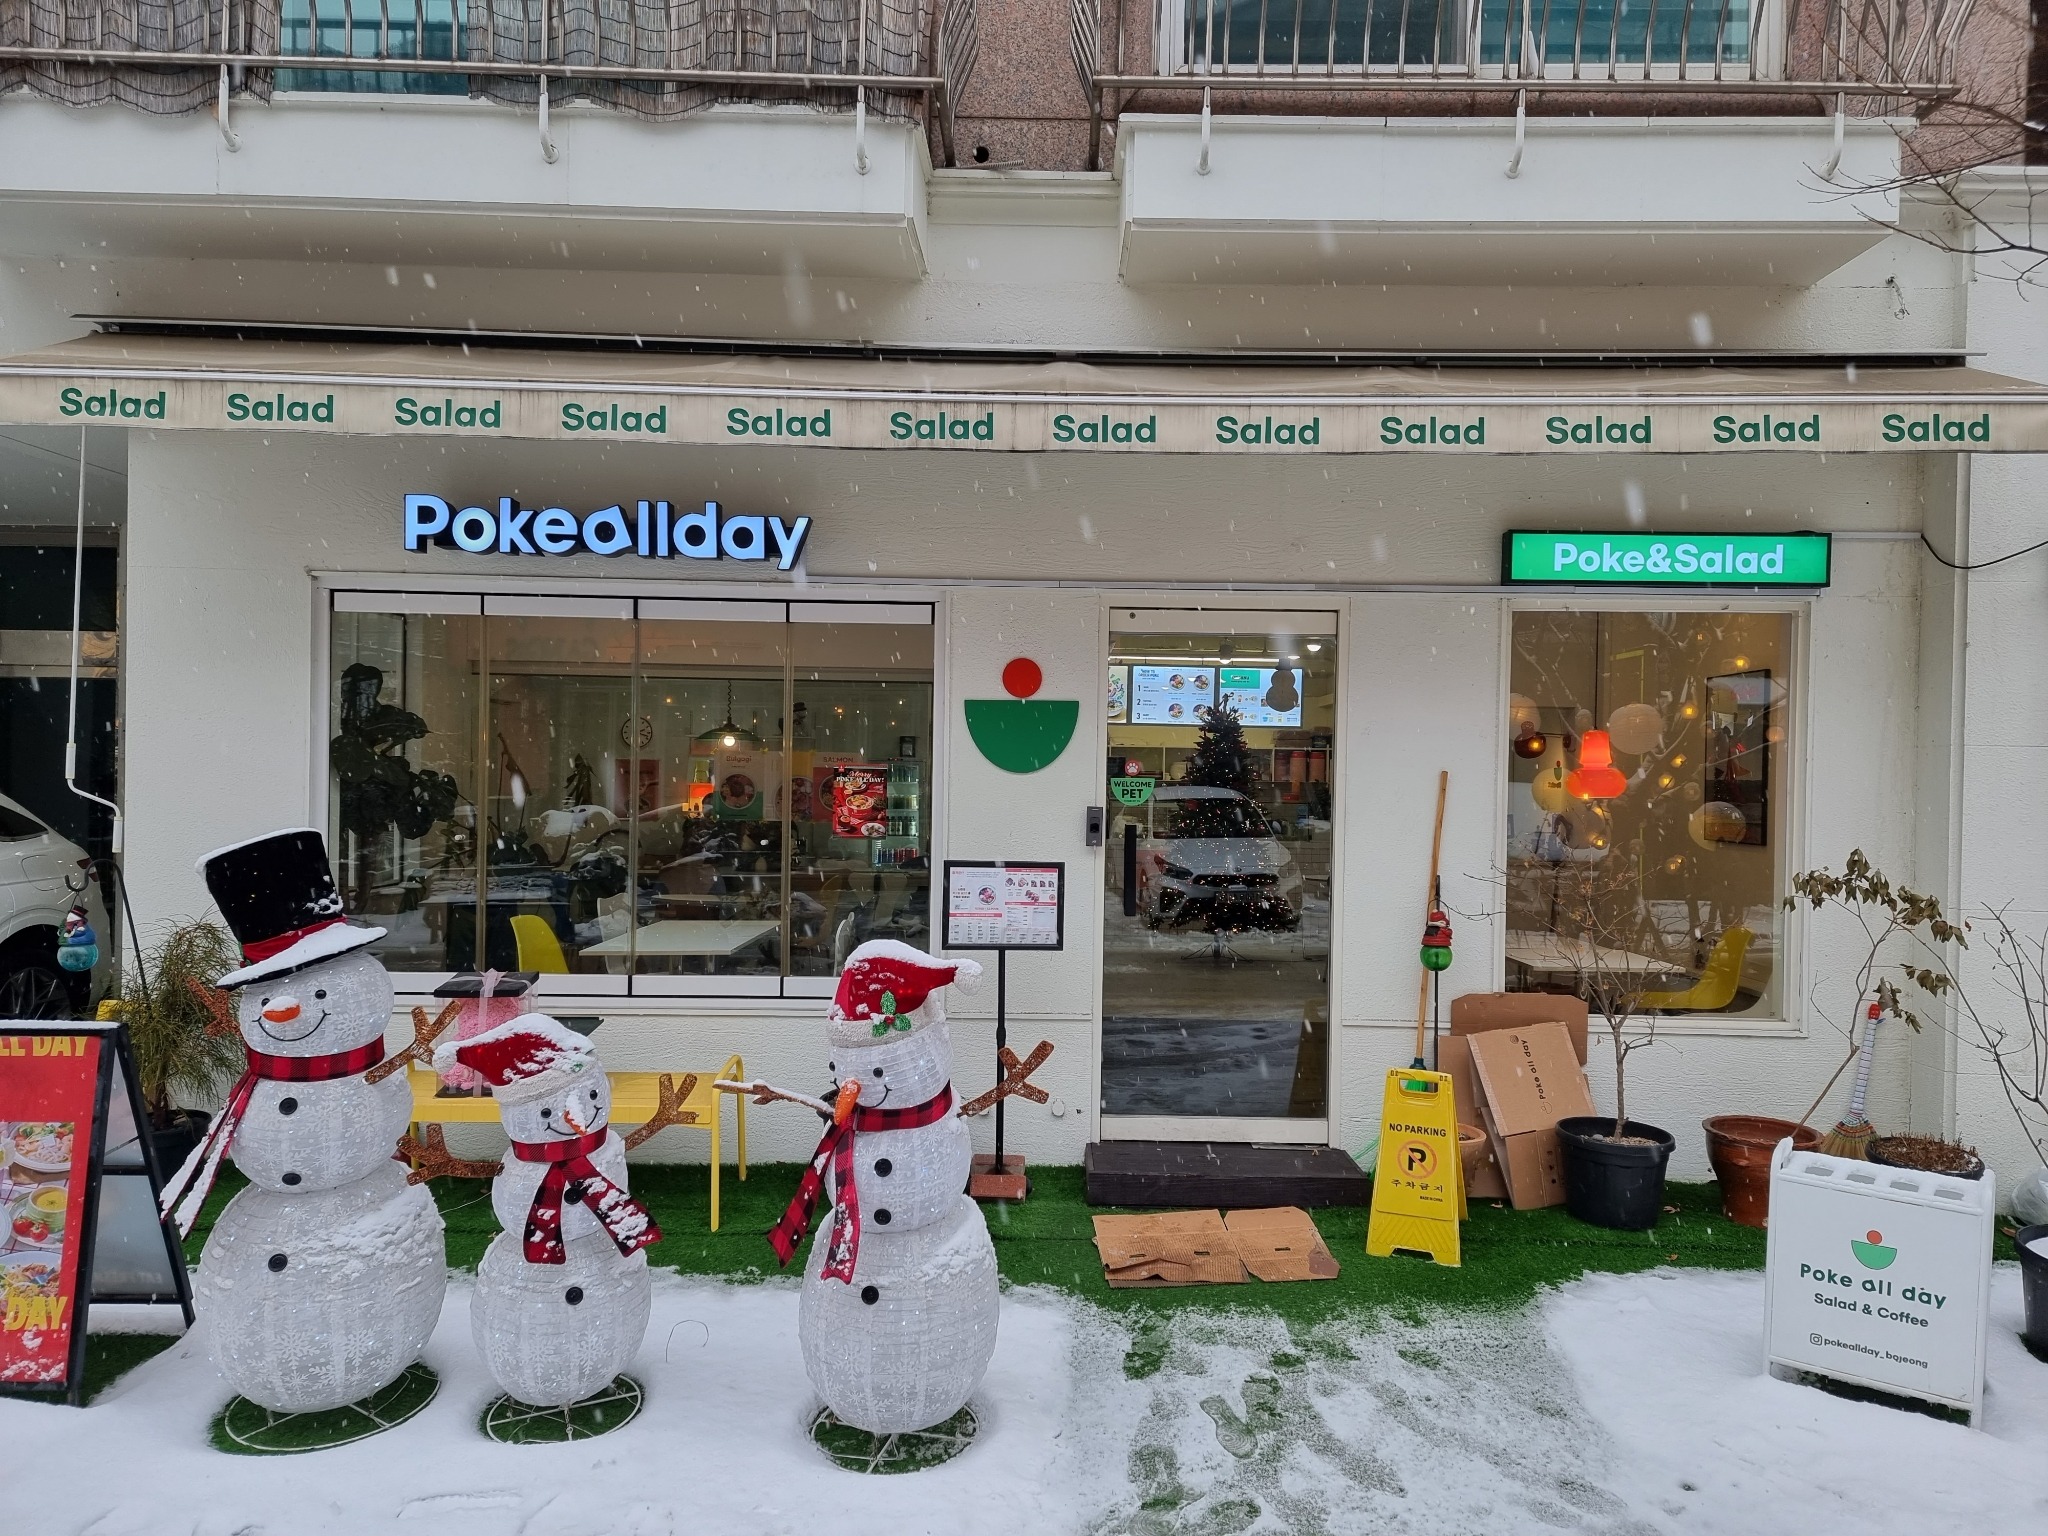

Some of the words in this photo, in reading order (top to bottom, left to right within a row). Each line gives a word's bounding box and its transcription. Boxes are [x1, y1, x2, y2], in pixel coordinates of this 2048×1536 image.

[59, 387, 166, 420] Salad
[227, 393, 334, 423] Salad
[395, 397, 501, 429] Salad
[562, 403, 667, 434] Salad
[727, 408, 831, 438] Salad
[890, 412, 994, 441] Salad
[1053, 415, 1157, 444] Salad
[1216, 416, 1320, 445] Salad
[1380, 416, 1485, 445] Salad
[1546, 416, 1652, 445] Salad
[1713, 414, 1820, 444] Salad
[1882, 413, 1991, 443] Salad
[404, 494, 811, 571] Pokeallday
[1553, 543, 1784, 575] Poke&Salad
[1121, 789, 1144, 799] PET
[32, 1037, 87, 1056] DAY
[1520, 1039, 1532, 1058] day
[1527, 1060, 1537, 1074] all
[1389, 1122, 1403, 1132] NO
[1404, 1124, 1447, 1138] PARKING
[1391, 1178, 1443, 1193] 주차금지
[1800, 1263, 1853, 1287] Poke
[1861, 1279, 1892, 1296] all
[1901, 1286, 1947, 1309] day
[4, 1296, 68, 1330] DAY
[1814, 1293, 1857, 1311] Salad
[1861, 1303, 1873, 1316] &
[1877, 1307, 1929, 1327] Coffee
